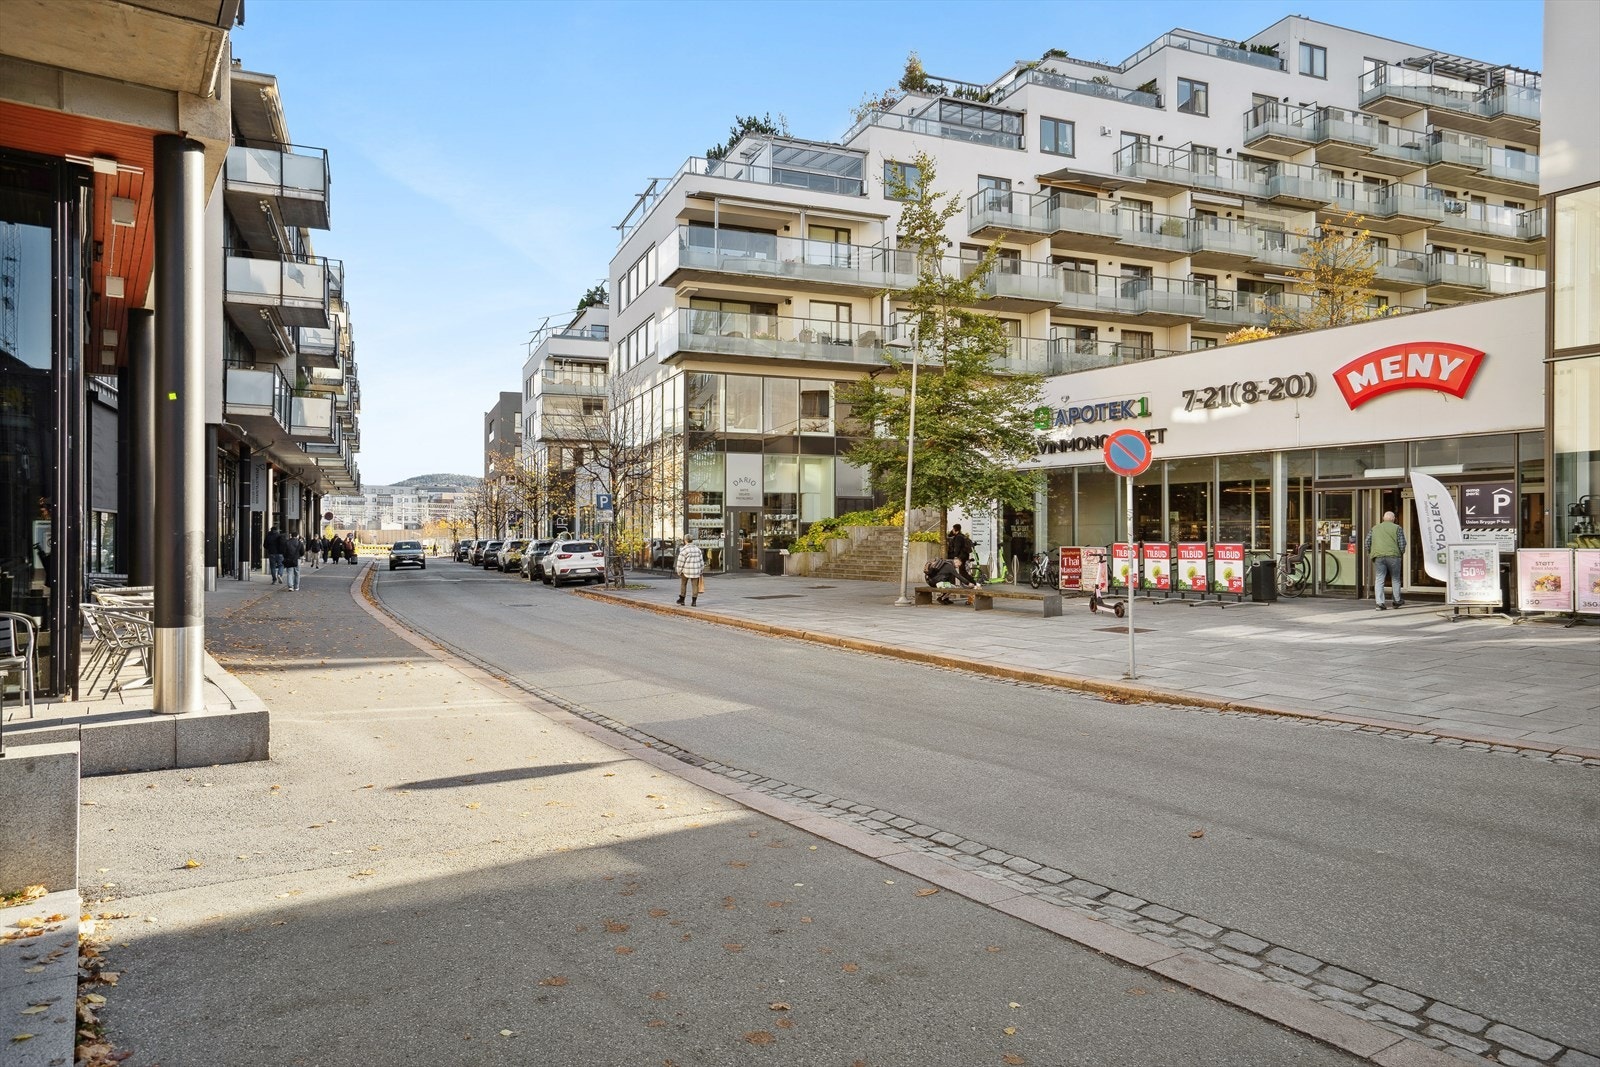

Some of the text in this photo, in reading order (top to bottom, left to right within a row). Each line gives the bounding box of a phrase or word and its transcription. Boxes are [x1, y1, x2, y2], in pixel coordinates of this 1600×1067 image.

[1346, 353, 1464, 394] MENY
[1055, 399, 1136, 426] APOTEK
[1037, 427, 1167, 454] VINMONOET
[732, 476, 757, 487] DARIO
[600, 495, 609, 509] P
[1493, 494, 1511, 515] P
[1116, 549, 1136, 557] TILBD
[1146, 550, 1167, 558] TILBUD
[1180, 550, 1203, 559] TILBUD
[1217, 551, 1240, 560] TILBUD
[1063, 556, 1080, 566] Thai
[1462, 567, 1485, 577] 50%
